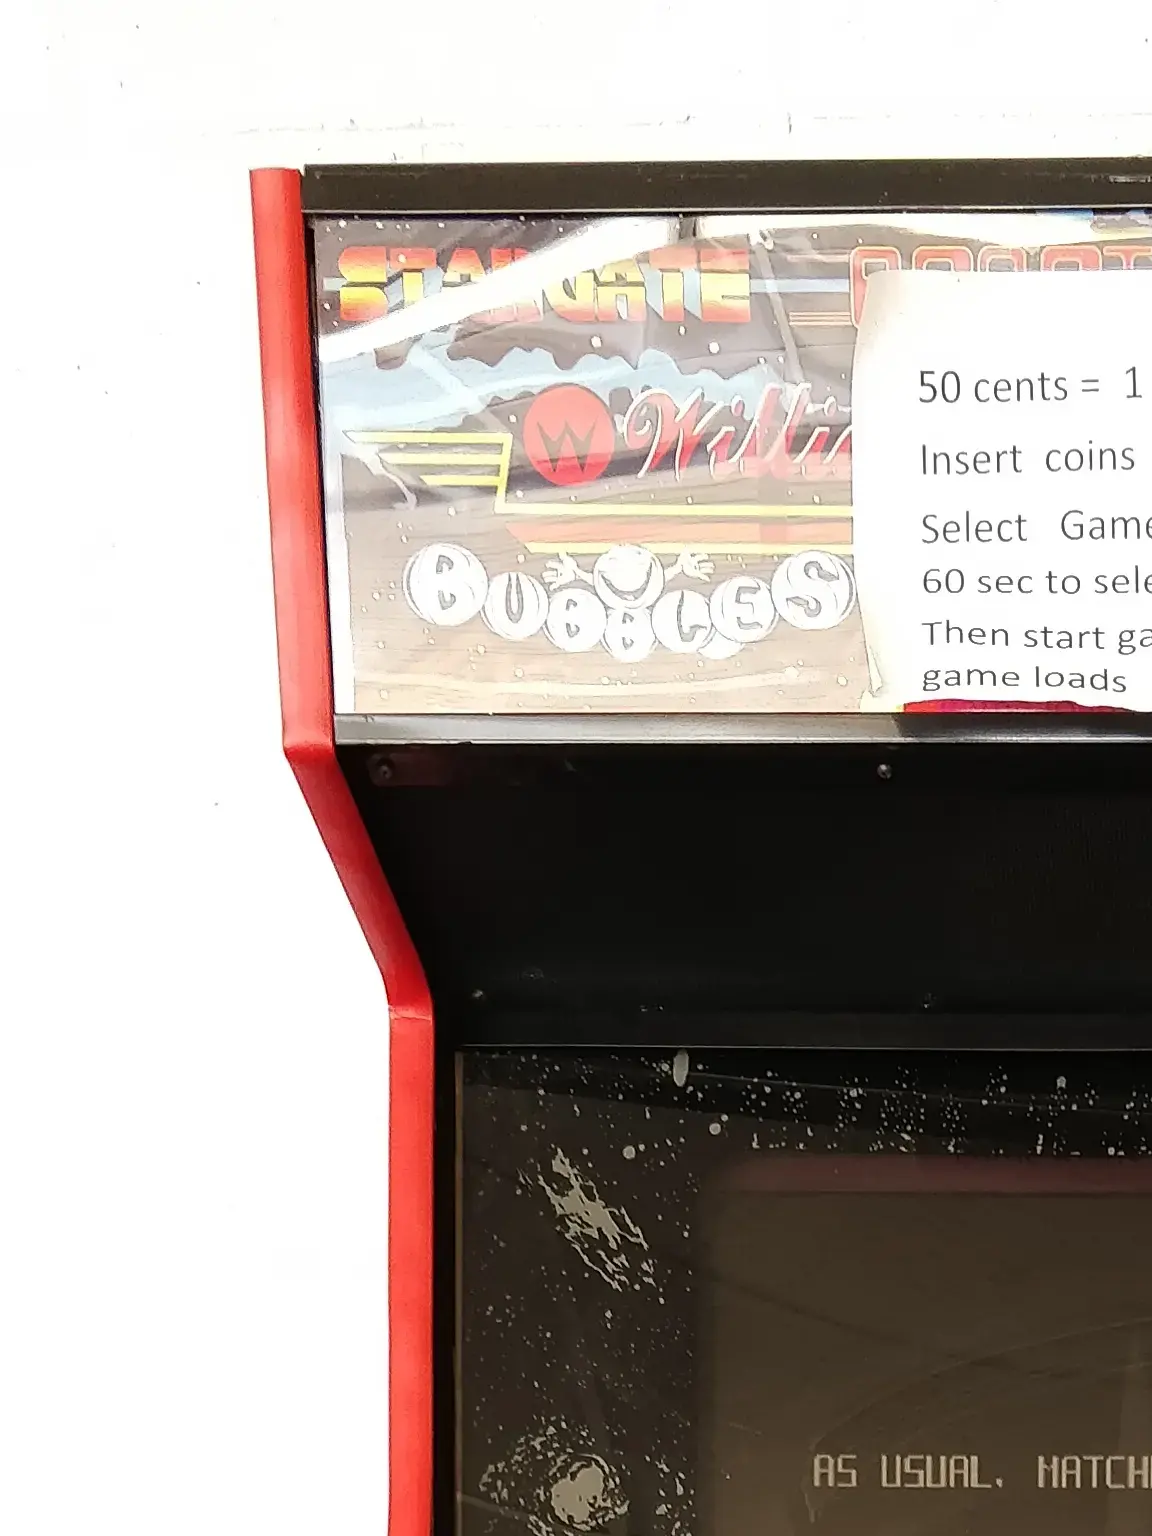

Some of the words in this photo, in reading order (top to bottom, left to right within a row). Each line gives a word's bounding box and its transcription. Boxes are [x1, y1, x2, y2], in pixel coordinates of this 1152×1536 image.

[919, 370, 960, 403] 50
[974, 372, 1067, 403] cents
[1081, 379, 1098, 392] =
[1125, 366, 1142, 399] 1
[623, 382, 852, 482] Willi
[922, 444, 1022, 475] Insert
[1045, 440, 1135, 472] coins
[922, 510, 1027, 544] Select
[923, 568, 965, 594] 60
[977, 575, 1033, 594] sec
[1045, 570, 1081, 595] to
[415, 547, 845, 655] BUBBLES
[921, 619, 1009, 647] Then
[1024, 626, 1105, 650] start
[922, 668, 1020, 692] game
[1035, 665, 1127, 693] loads
[813, 1454, 857, 1488] AS
